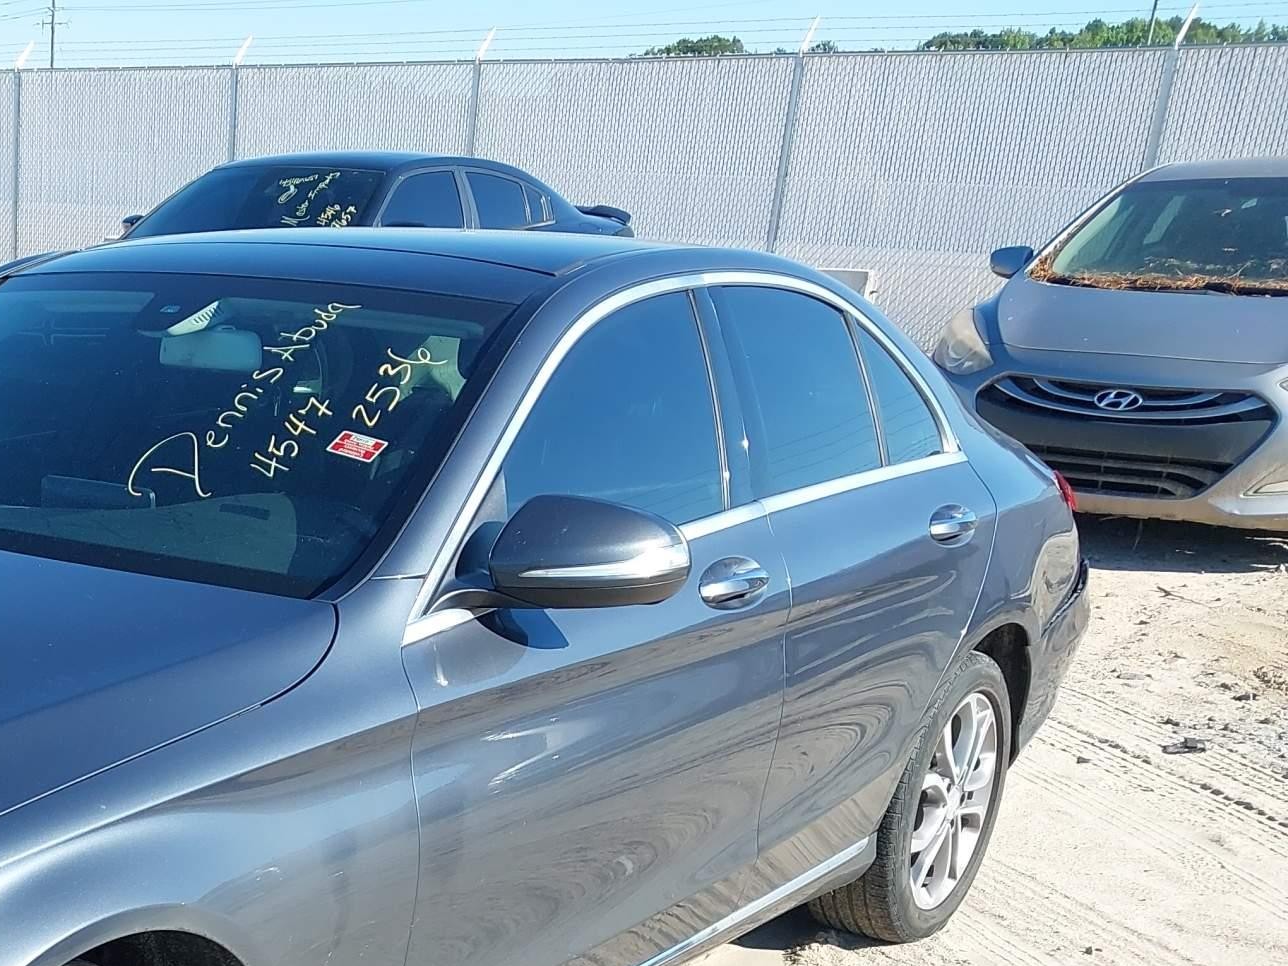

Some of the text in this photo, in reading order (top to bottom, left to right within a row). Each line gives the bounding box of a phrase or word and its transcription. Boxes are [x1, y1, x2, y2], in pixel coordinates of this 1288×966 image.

[352, 347, 448, 426] 2536
[128, 367, 284, 497] Dennis
[251, 396, 332, 478] 4547
